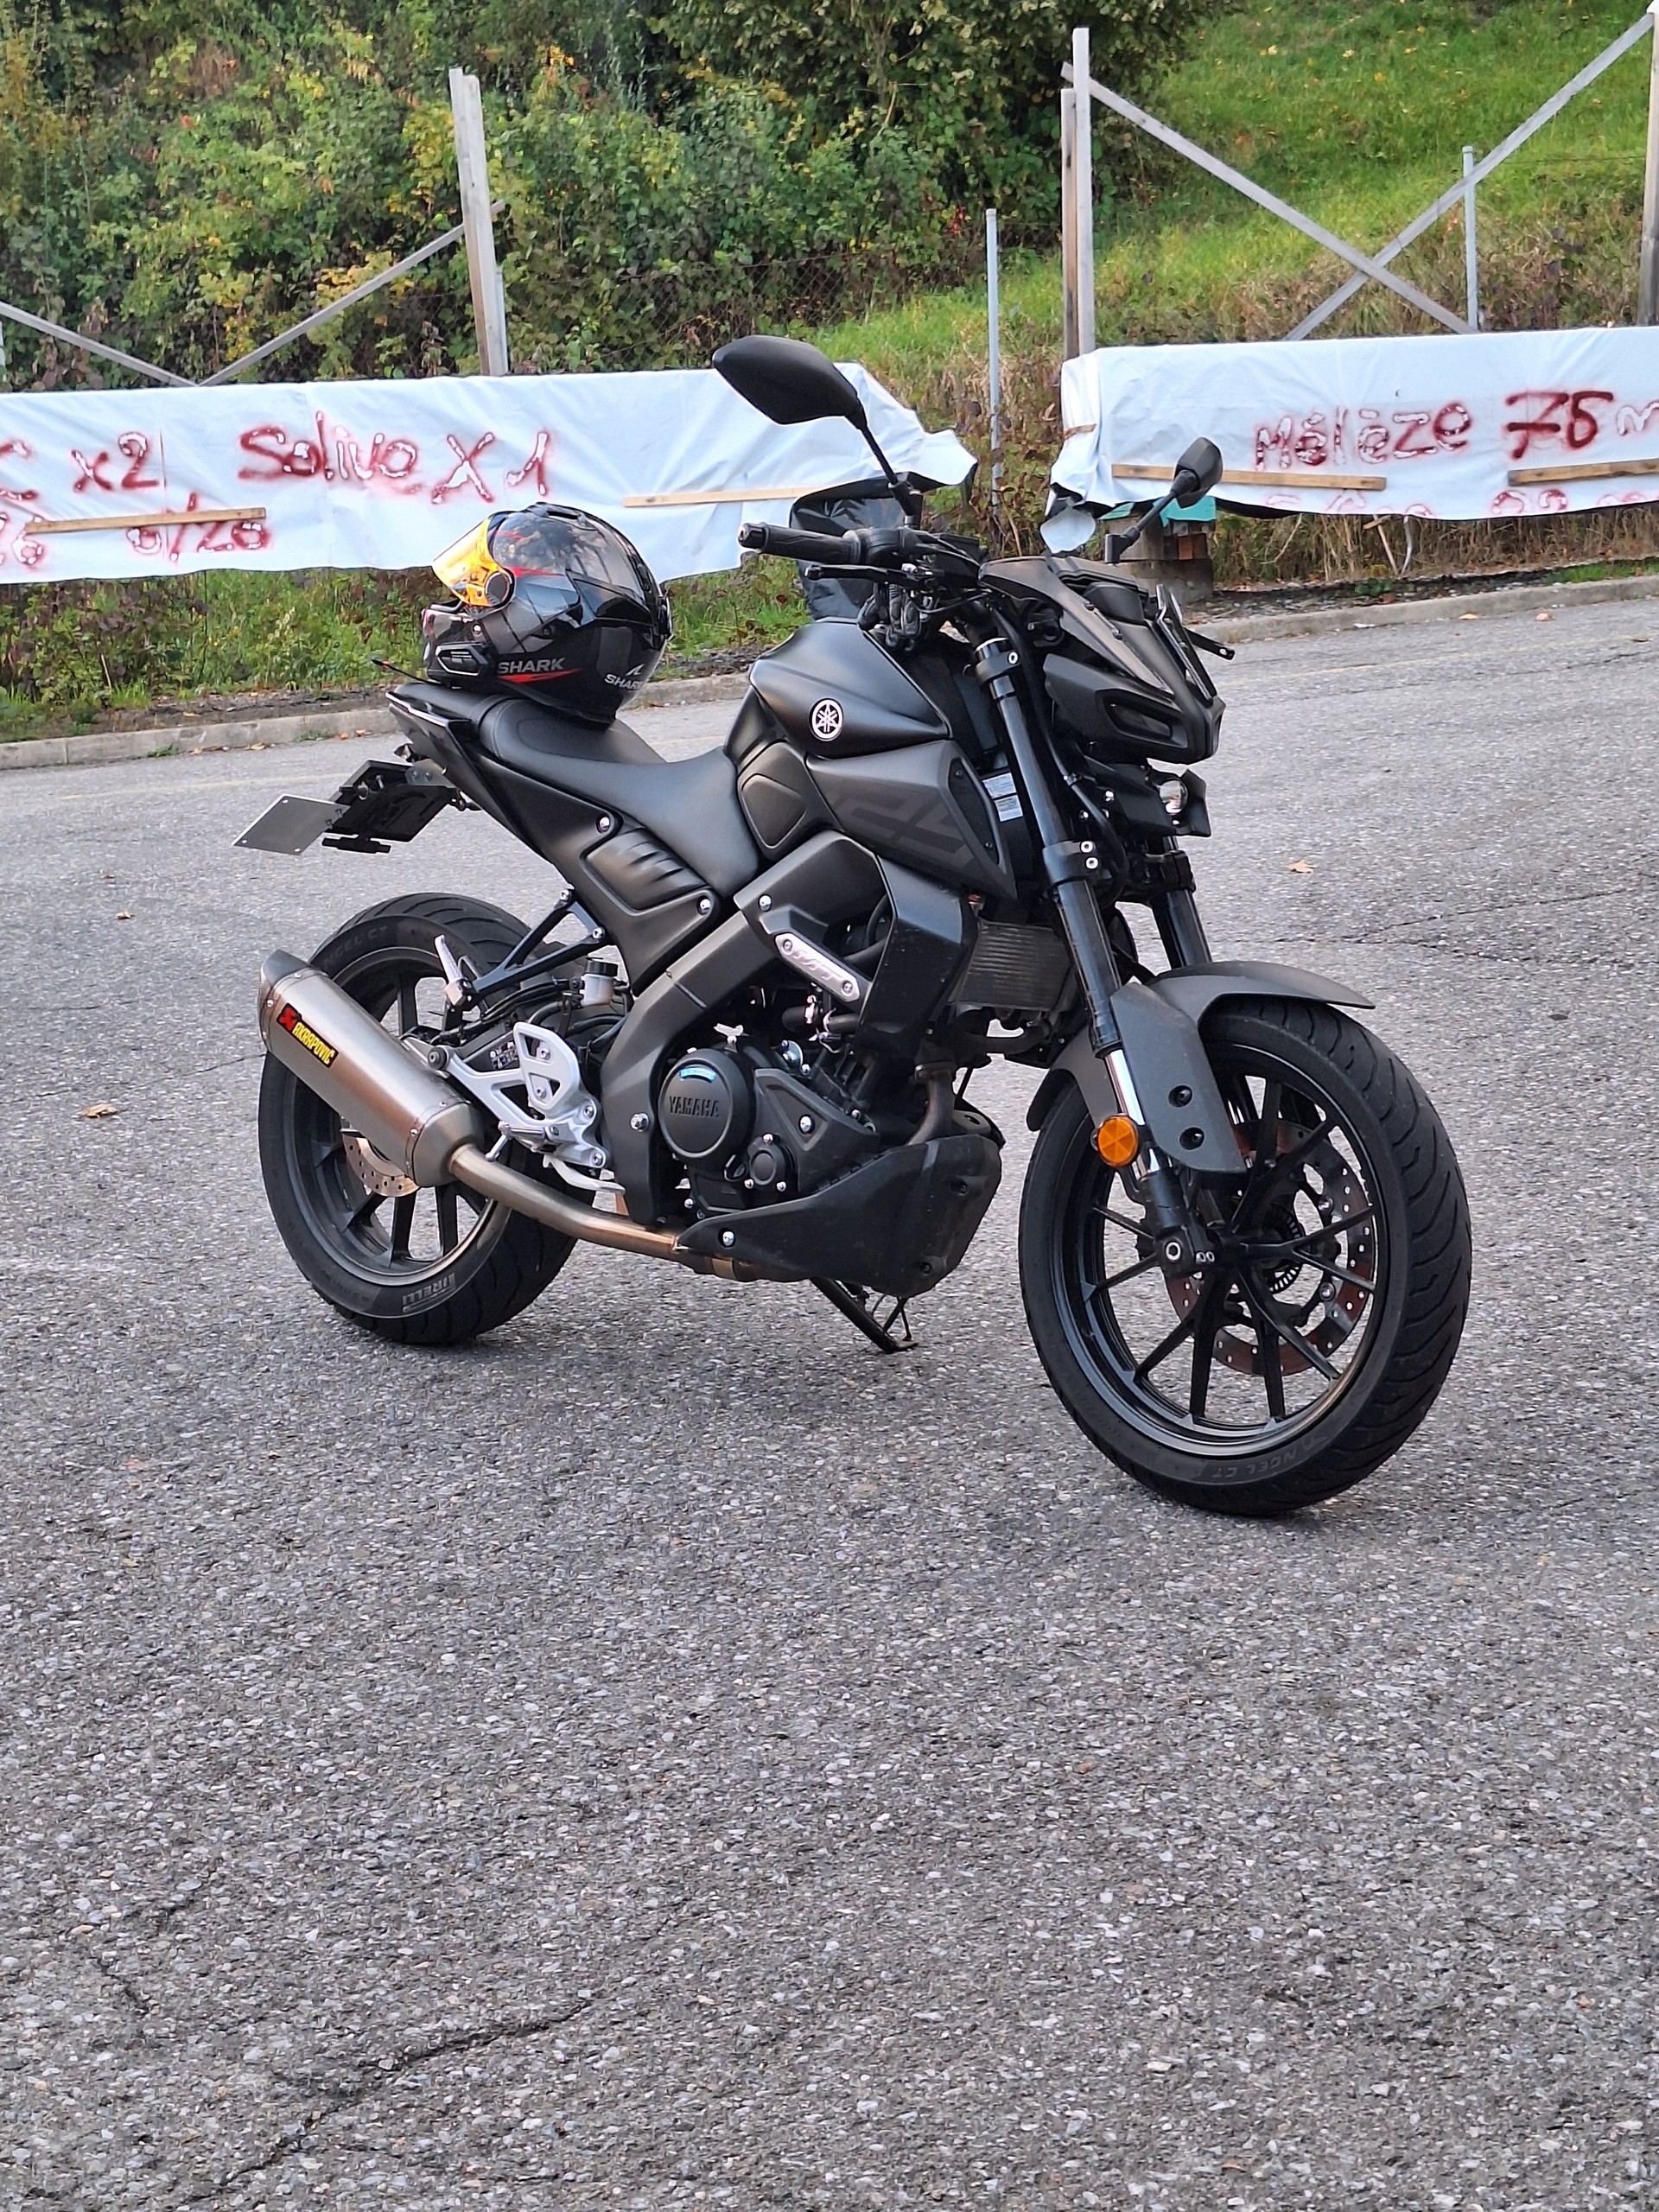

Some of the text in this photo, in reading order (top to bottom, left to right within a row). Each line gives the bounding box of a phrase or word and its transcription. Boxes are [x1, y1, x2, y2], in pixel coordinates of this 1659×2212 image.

[497, 657, 565, 675] SHARK
[604, 672, 644, 690] SHAR
[669, 1096, 720, 1118] YAMAHA
[402, 1273, 457, 1313] PIRELLI
